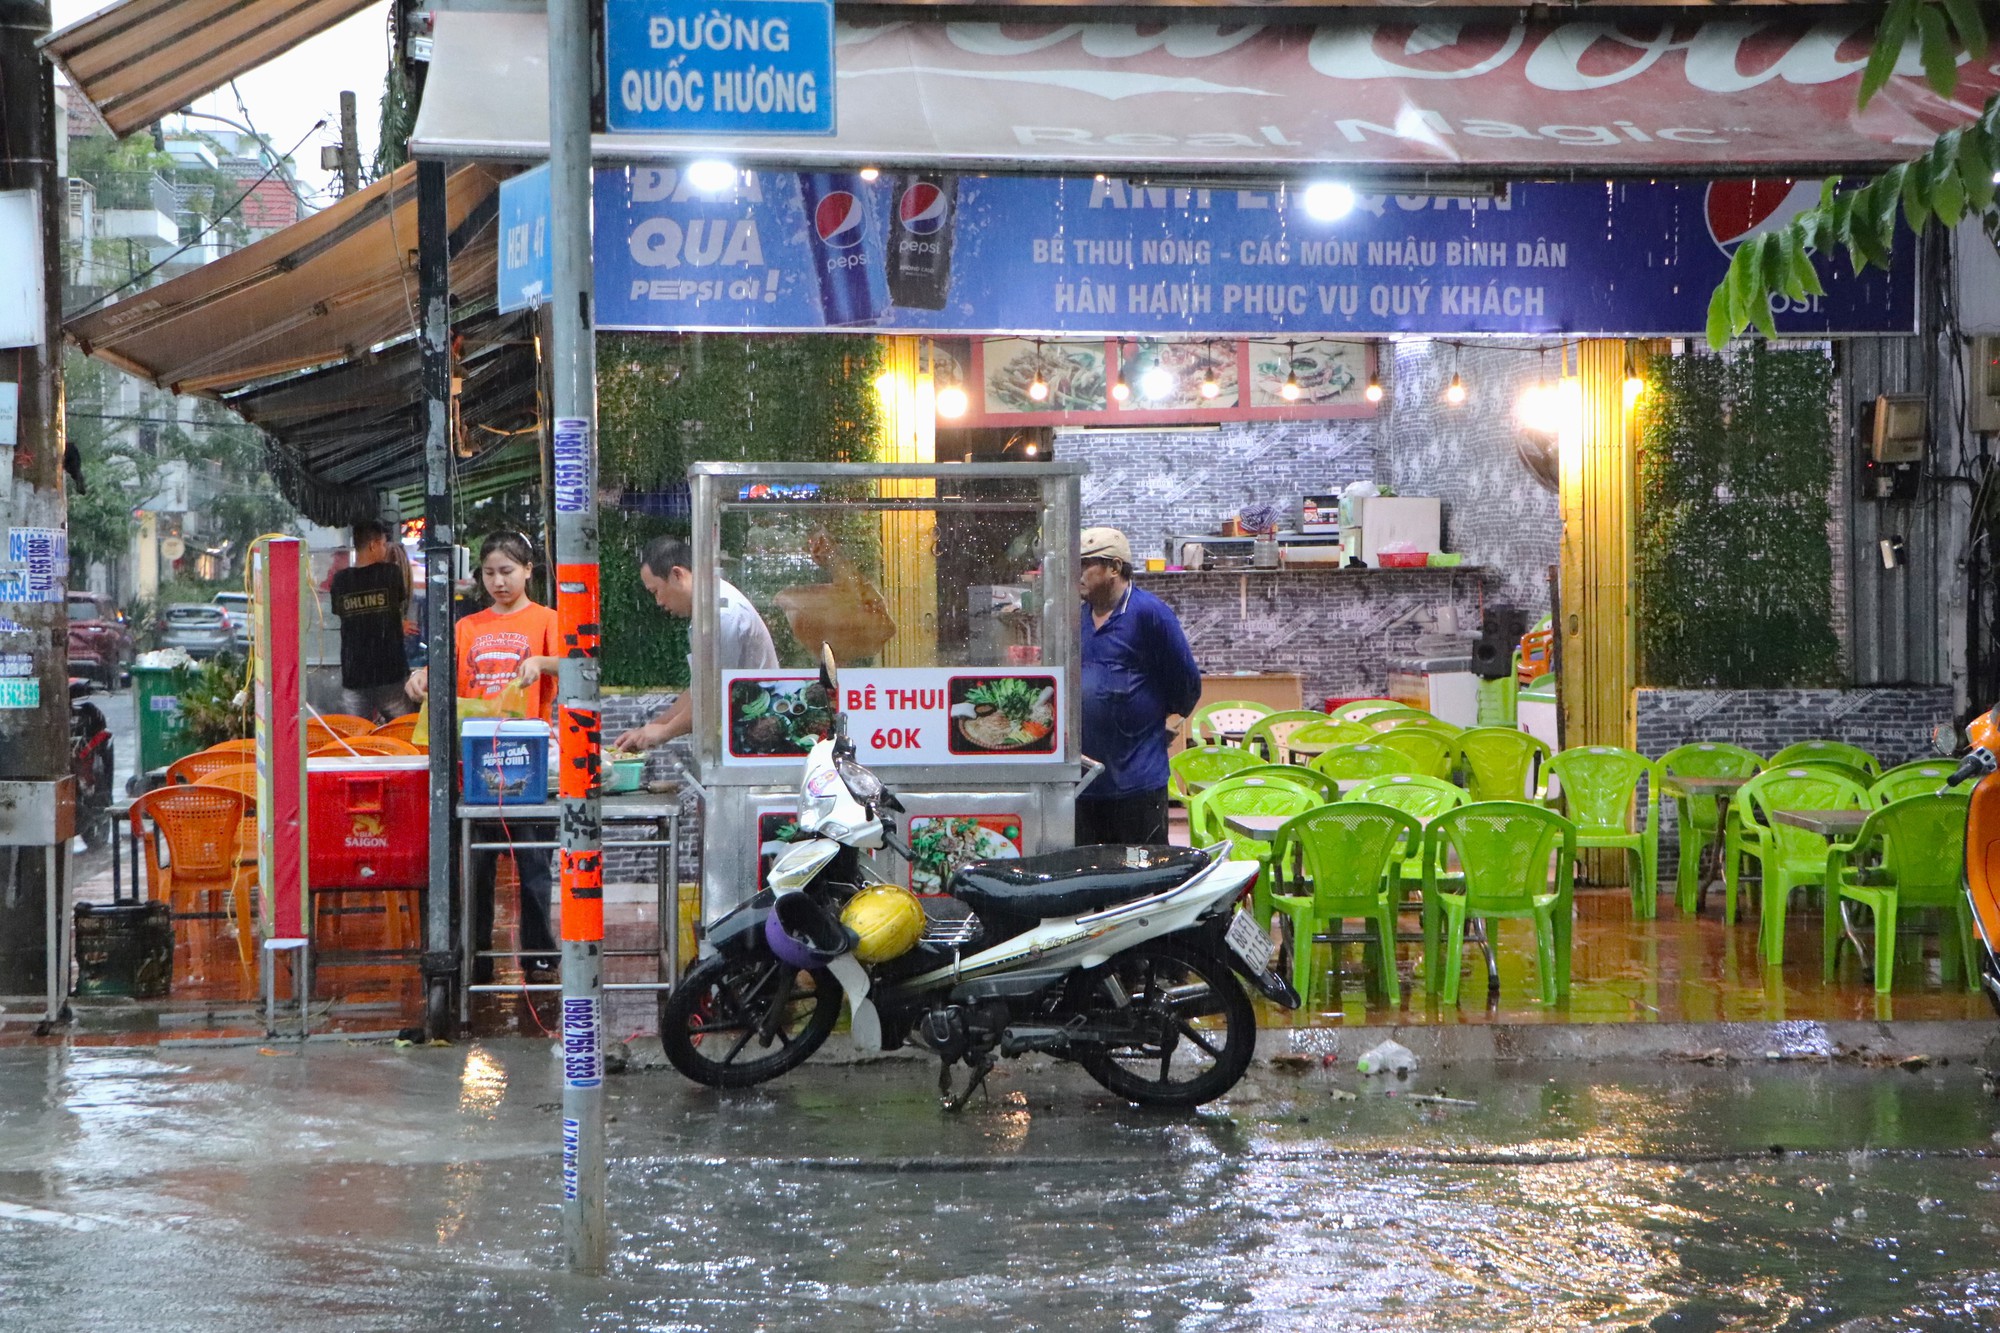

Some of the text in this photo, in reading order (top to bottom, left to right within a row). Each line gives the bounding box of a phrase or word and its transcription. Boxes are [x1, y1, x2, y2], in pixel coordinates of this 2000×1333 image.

[649, 8, 790, 52] ĐƯỜNG
[621, 55, 817, 113] QUỐC HƯƠNG
[1011, 110, 1730, 148] Real Magic
[630, 211, 764, 270] QUÁ
[899, 240, 941, 255] pepsi
[1033, 233, 1066, 265] BÊ
[1073, 240, 1133, 265] THUI
[1142, 234, 1211, 265] NÓNG
[1240, 235, 1291, 266] CÁC
[1300, 235, 1358, 266] MÓN
[1367, 235, 1437, 272] NHẬU
[1446, 235, 1507, 267] BÌNH
[1516, 237, 1567, 268] DÂN
[630, 280, 724, 301] PEPSI
[1055, 277, 1545, 322] HÂN HẠNH PHỤC VỤ QUÝ KHÁCH
[847, 684, 944, 710] BÊ THUI
[871, 728, 921, 749] 60K
[345, 837, 388, 848] SAIGON
